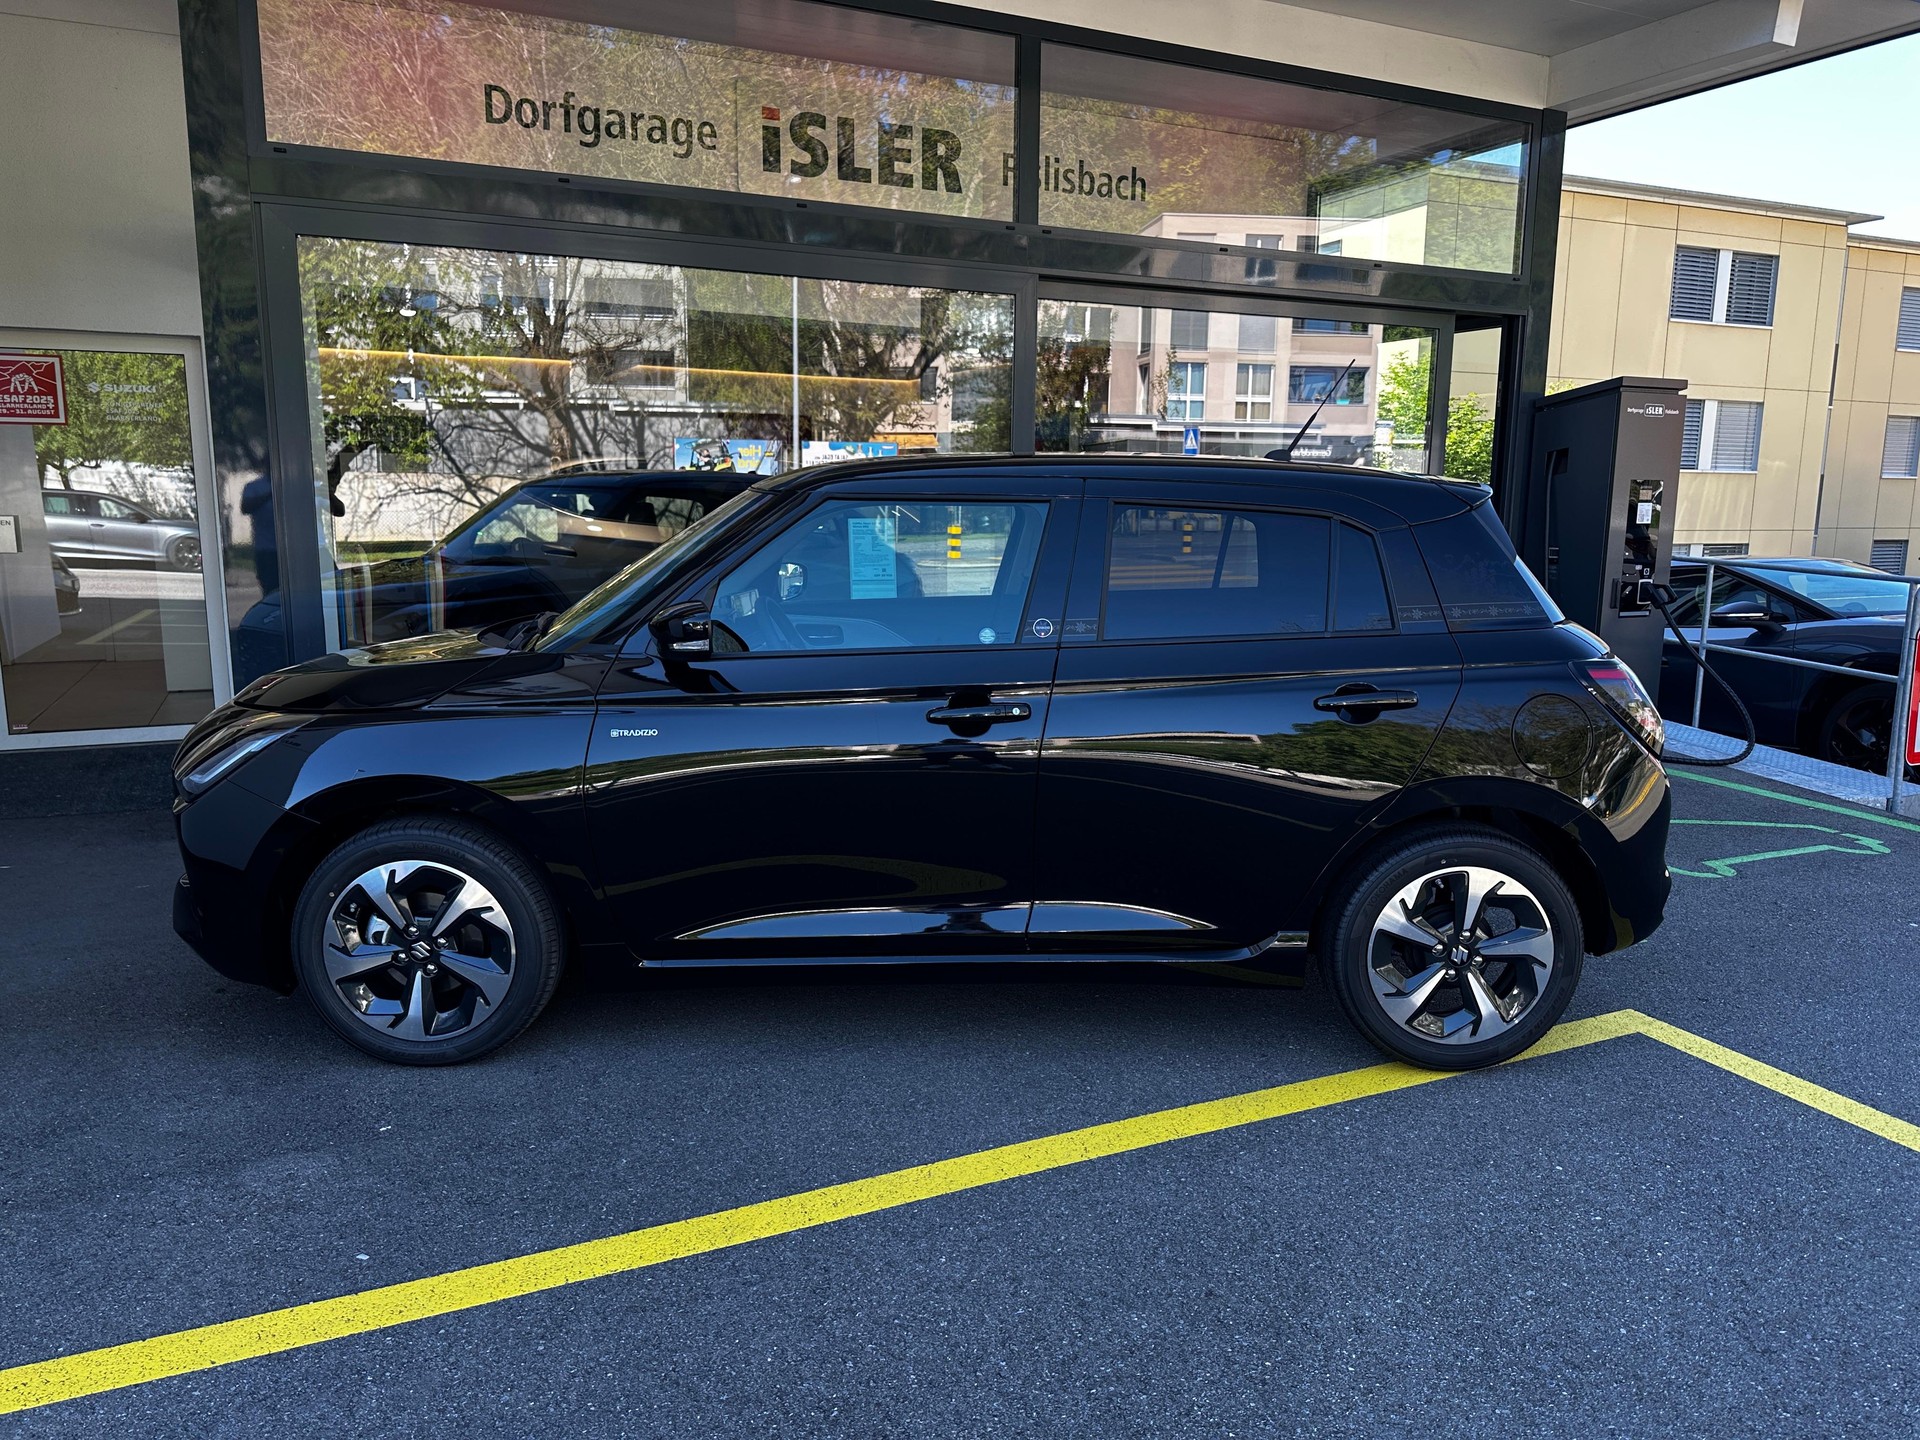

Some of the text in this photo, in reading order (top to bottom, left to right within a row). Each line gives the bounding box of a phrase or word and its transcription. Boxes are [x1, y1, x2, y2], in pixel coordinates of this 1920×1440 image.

[484, 83, 1147, 202] Dorfgarage iSLER Flisbach
[103, 384, 157, 393] SUZUKI
[26, 395, 54, 404] 2025
[1645, 406, 1663, 415] iSLER
